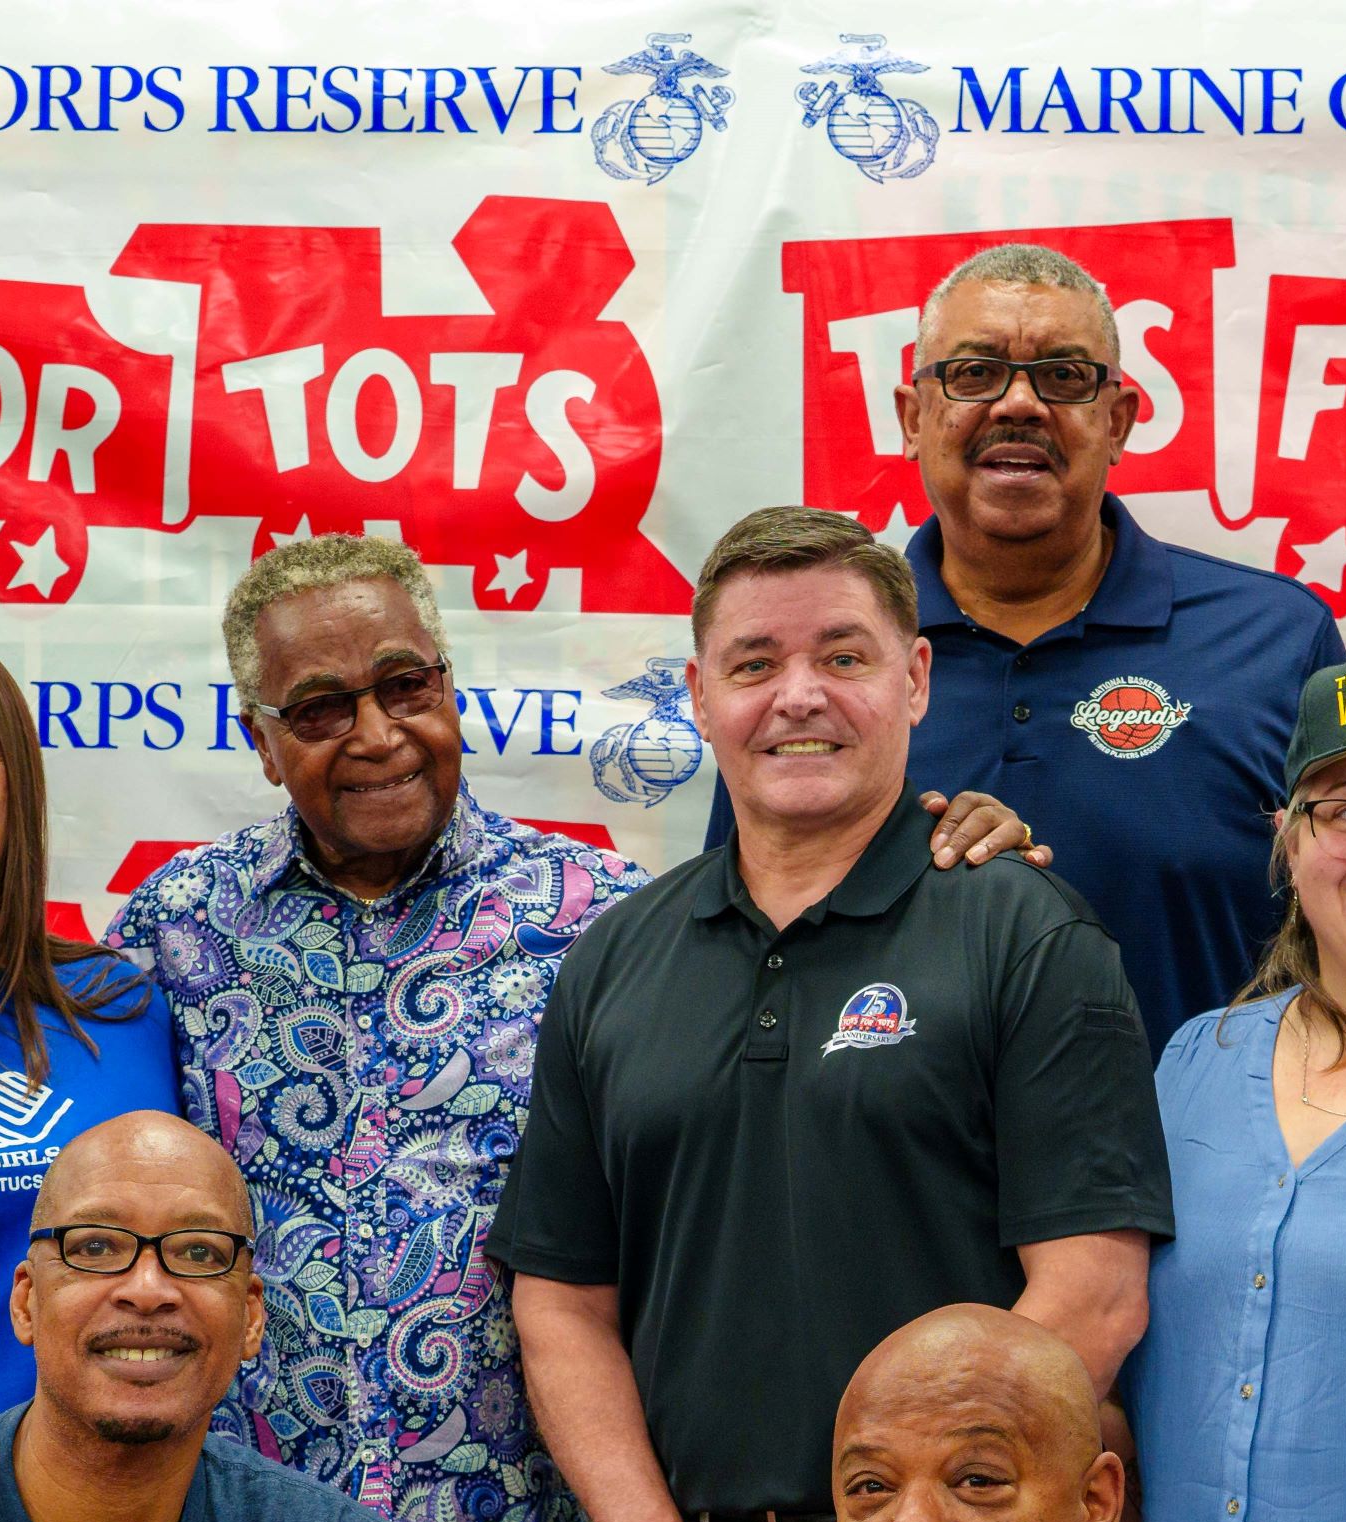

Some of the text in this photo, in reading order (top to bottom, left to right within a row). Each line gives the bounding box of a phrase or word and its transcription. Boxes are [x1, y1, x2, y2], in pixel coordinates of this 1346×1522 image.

[208, 65, 583, 135] RESERVE
[952, 66, 1304, 135] MARINE
[828, 284, 1184, 456] TS
[222, 344, 597, 522] TOTS
[1089, 675, 1171, 702] NATIONAL BASKETBALL
[31, 681, 186, 751] RPS
[1073, 701, 1181, 732] Legends
[1110, 749, 1140, 759] PLAYERS
[842, 1032, 890, 1043] ANNIVERSARY
[859, 1017, 874, 1026] FOR
[877, 1018, 896, 1027] TOTS
